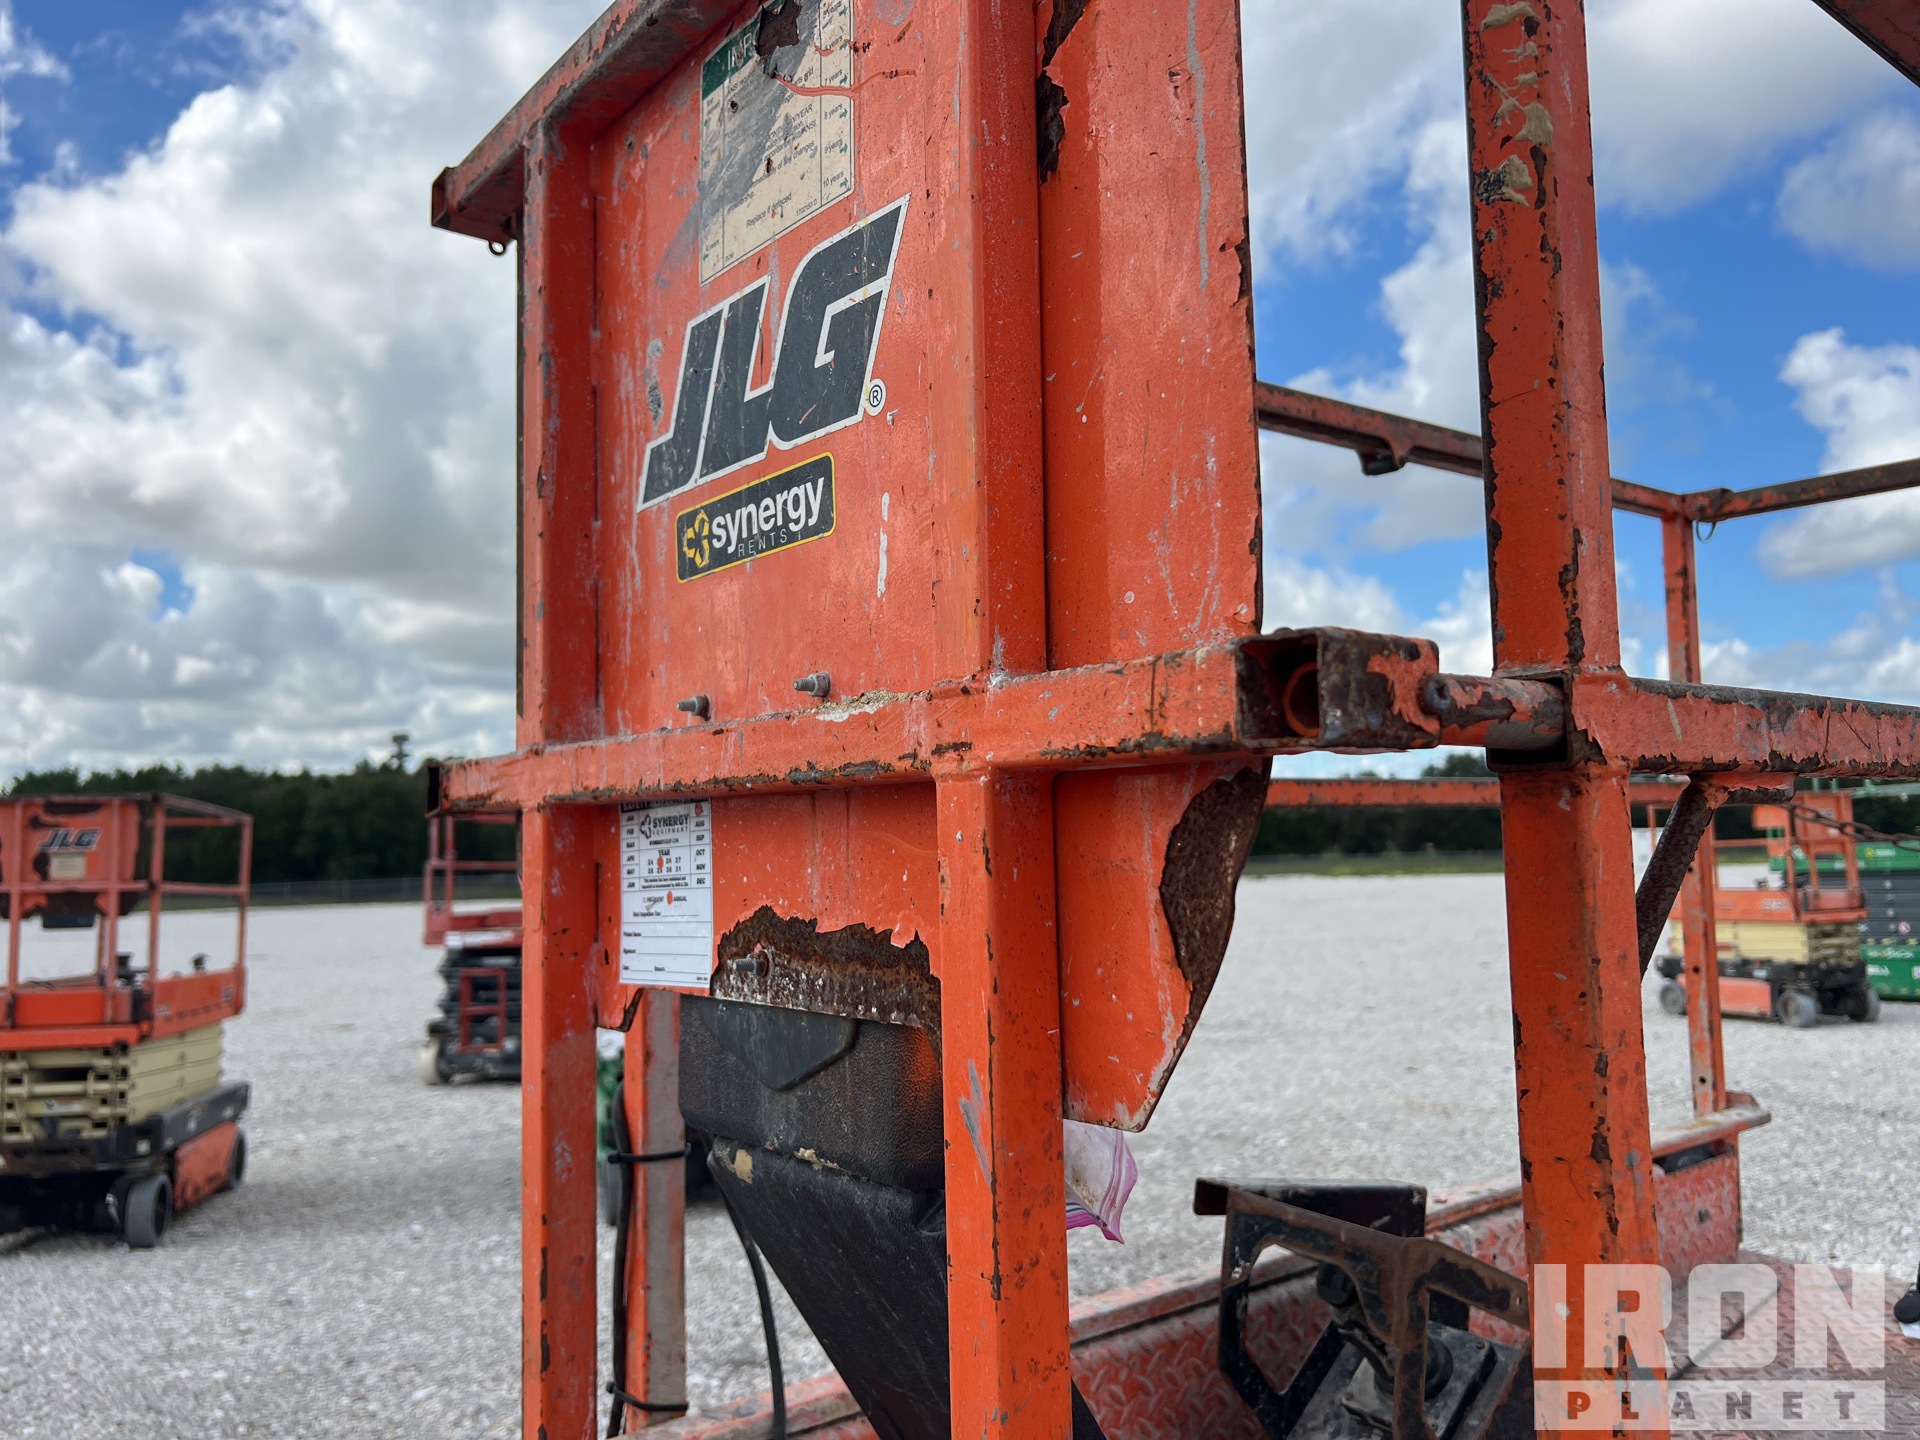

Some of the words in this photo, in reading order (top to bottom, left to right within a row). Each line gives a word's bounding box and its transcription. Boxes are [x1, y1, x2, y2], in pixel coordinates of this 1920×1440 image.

[829, 69, 843, 83] years
[829, 103, 843, 118] years
[829, 137, 844, 154] years
[830, 170, 844, 186] years
[746, 210, 767, 228] Replace
[771, 191, 792, 212] defaced
[637, 195, 909, 511] JLG
[711, 477, 825, 554] synergy
[737, 528, 788, 557] RENTS
[653, 814, 690, 829] SYNERGY
[39, 828, 101, 851] JLG
[653, 827, 688, 836] EQUIPMENT
